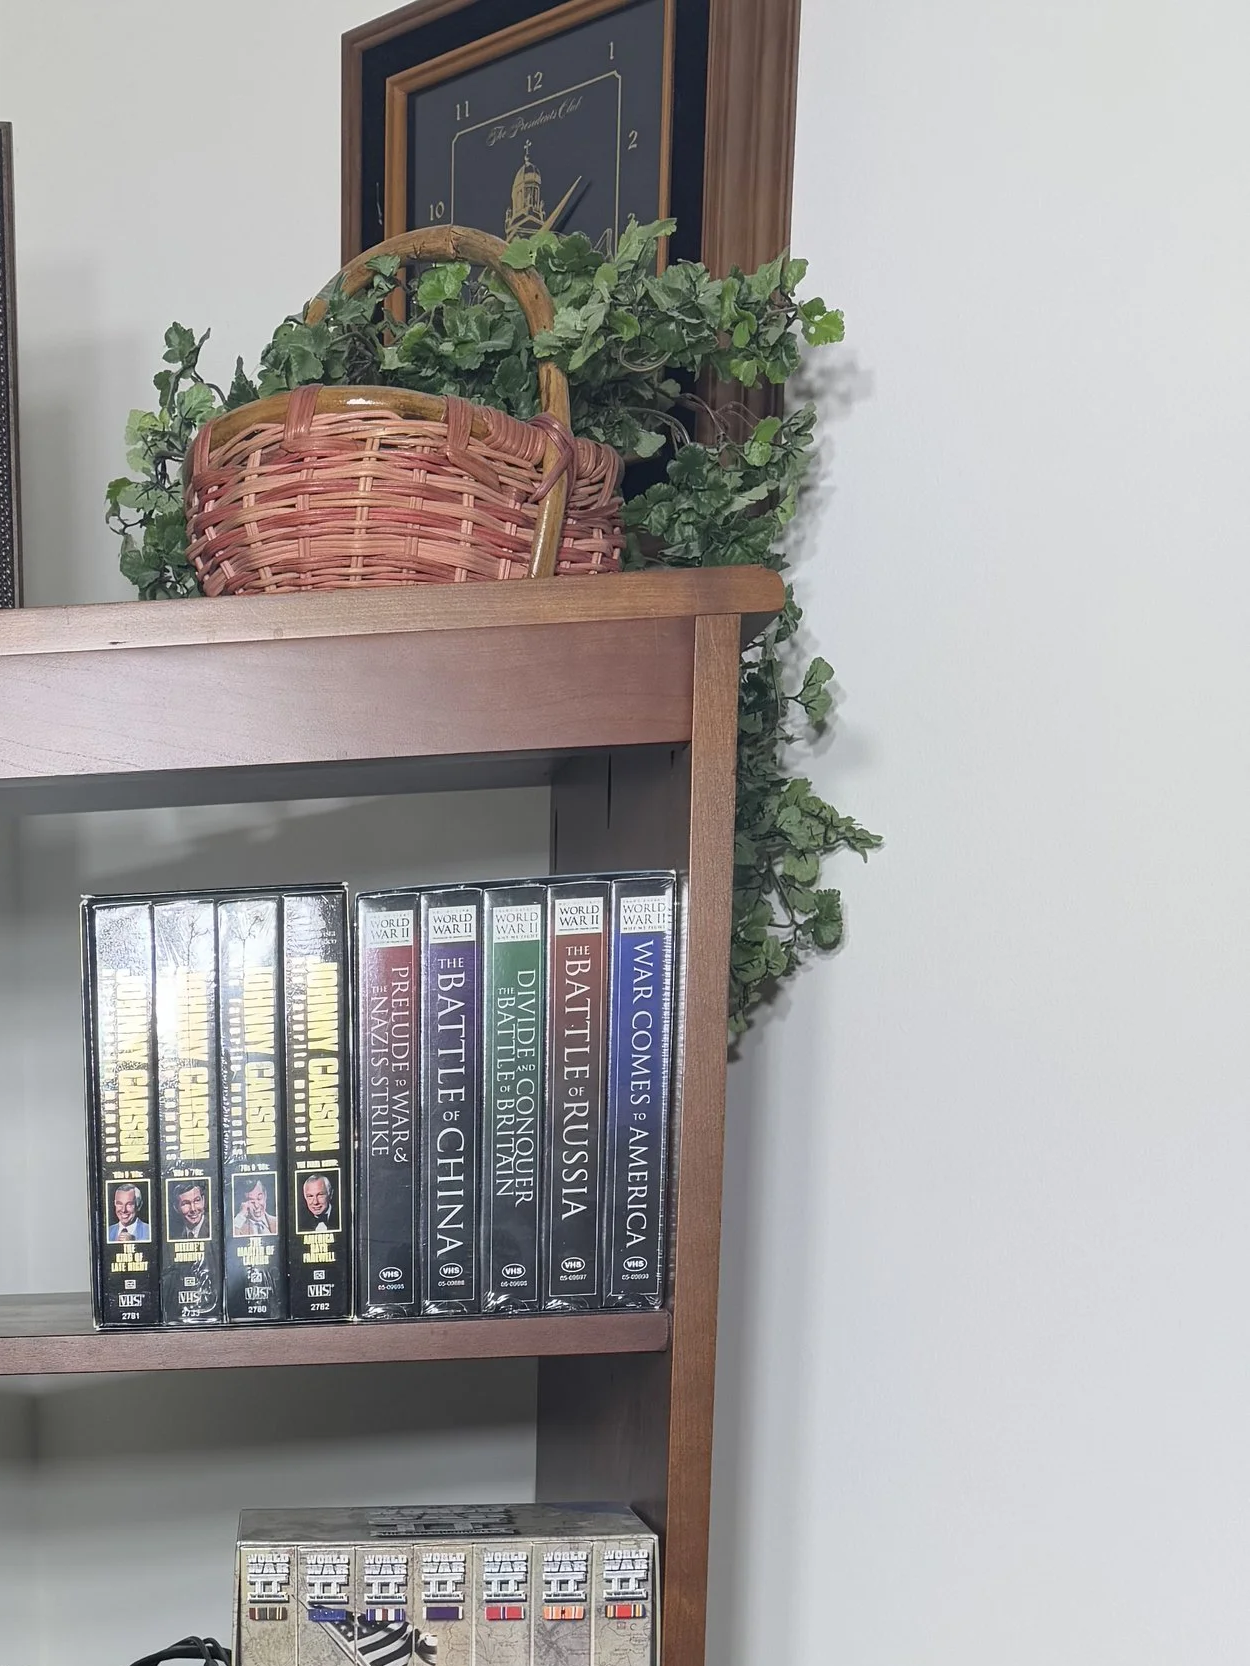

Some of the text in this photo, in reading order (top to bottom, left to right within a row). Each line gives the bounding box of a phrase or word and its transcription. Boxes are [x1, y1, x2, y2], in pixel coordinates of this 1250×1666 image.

[608, 41, 615, 61] 1
[526, 71, 543, 93] 12
[455, 101, 470, 121] 11
[628, 130, 638, 150] 2
[429, 201, 445, 221] 10
[559, 905, 600, 915] WORLD
[622, 902, 666, 913] WORLD
[433, 913, 473, 924] WORLD
[495, 912, 539, 923] WORLD
[559, 914, 599, 926] WAR II
[623, 913, 666, 925] WAR II
[433, 923, 472, 935] WAR II
[496, 923, 538, 934] WAR II
[565, 945, 590, 956] THE
[437, 957, 465, 969] THE
[632, 940, 654, 1004] WAR
[306, 955, 339, 1053] JOHNNY
[391, 966, 410, 1073] PRELUDE
[564, 957, 591, 1081] BATTLE
[437, 971, 466, 1104] BATTLE
[630, 1010, 653, 1106] COMES
[370, 985, 389, 1156] THE NAZIS STRIKE
[496, 987, 516, 1196] THE BATTLE OF BRITAIN
[512, 969, 536, 1208] DIVIDE AND CONQUER
[568, 1086, 586, 1097] OF
[244, 1061, 276, 1155] CARSON
[308, 1057, 340, 1153] CARSON
[118, 1069, 150, 1163] CARSON
[178, 1066, 210, 1160] CARSON
[391, 1090, 410, 1146] WAR
[442, 1110, 461, 1122] OF
[633, 1112, 646, 1121] TO
[393, 1147, 409, 1163] &
[561, 1100, 590, 1221] RUSSIA
[436, 1127, 465, 1259] CHINA
[626, 1126, 650, 1249] AMERICA
[123, 1243, 136, 1253] THE
[111, 1262, 126, 1273] LATE
[178, 1291, 202, 1304] VHS
[244, 1287, 269, 1300] VHS
[308, 1284, 333, 1298] VHS
[119, 1294, 143, 1307] VHS
[248, 1553, 290, 1563] WORLD
[306, 1554, 349, 1564] WORLD
[364, 1554, 408, 1564] WORLD
[422, 1552, 466, 1562] WORLD
[484, 1552, 528, 1561] WORLD
[543, 1552, 587, 1561] WORLD
[604, 1549, 649, 1559] WORLD
